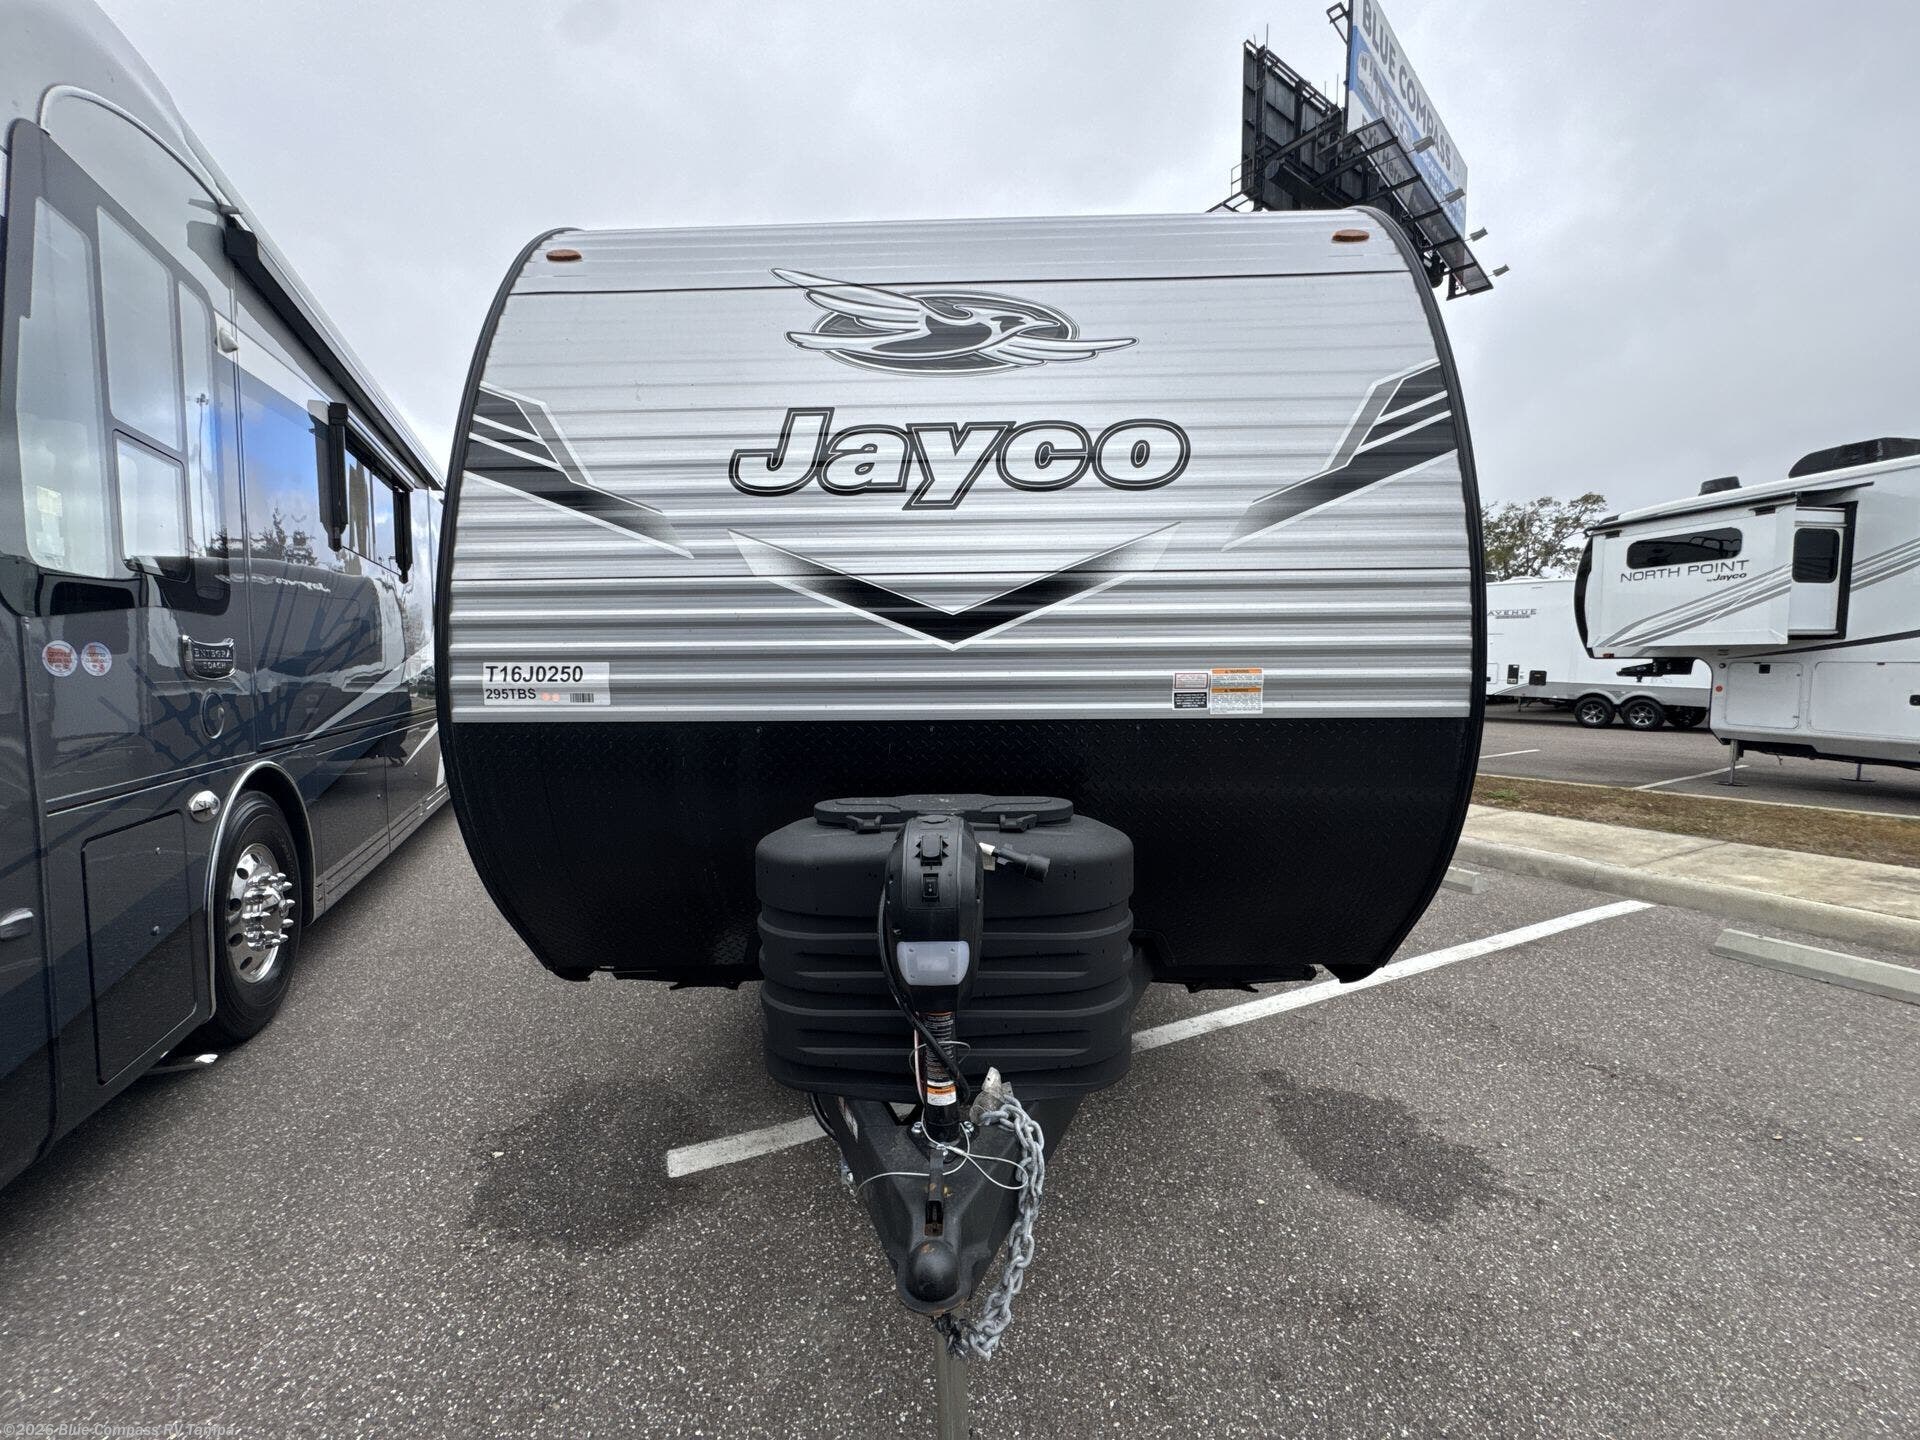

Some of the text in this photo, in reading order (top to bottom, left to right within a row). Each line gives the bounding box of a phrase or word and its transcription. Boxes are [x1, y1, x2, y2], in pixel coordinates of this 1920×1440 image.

[1362, 0, 1396, 82] BLUE
[1399, 65, 1451, 171] COMPASS
[728, 407, 1191, 509] Jayco
[1620, 559, 1749, 582] NORTH POINT
[1712, 572, 1748, 581] Jayco
[194, 648, 231, 658] ENTEGRA
[485, 666, 584, 682] T16J0250
[485, 688, 537, 700] 295TBS
